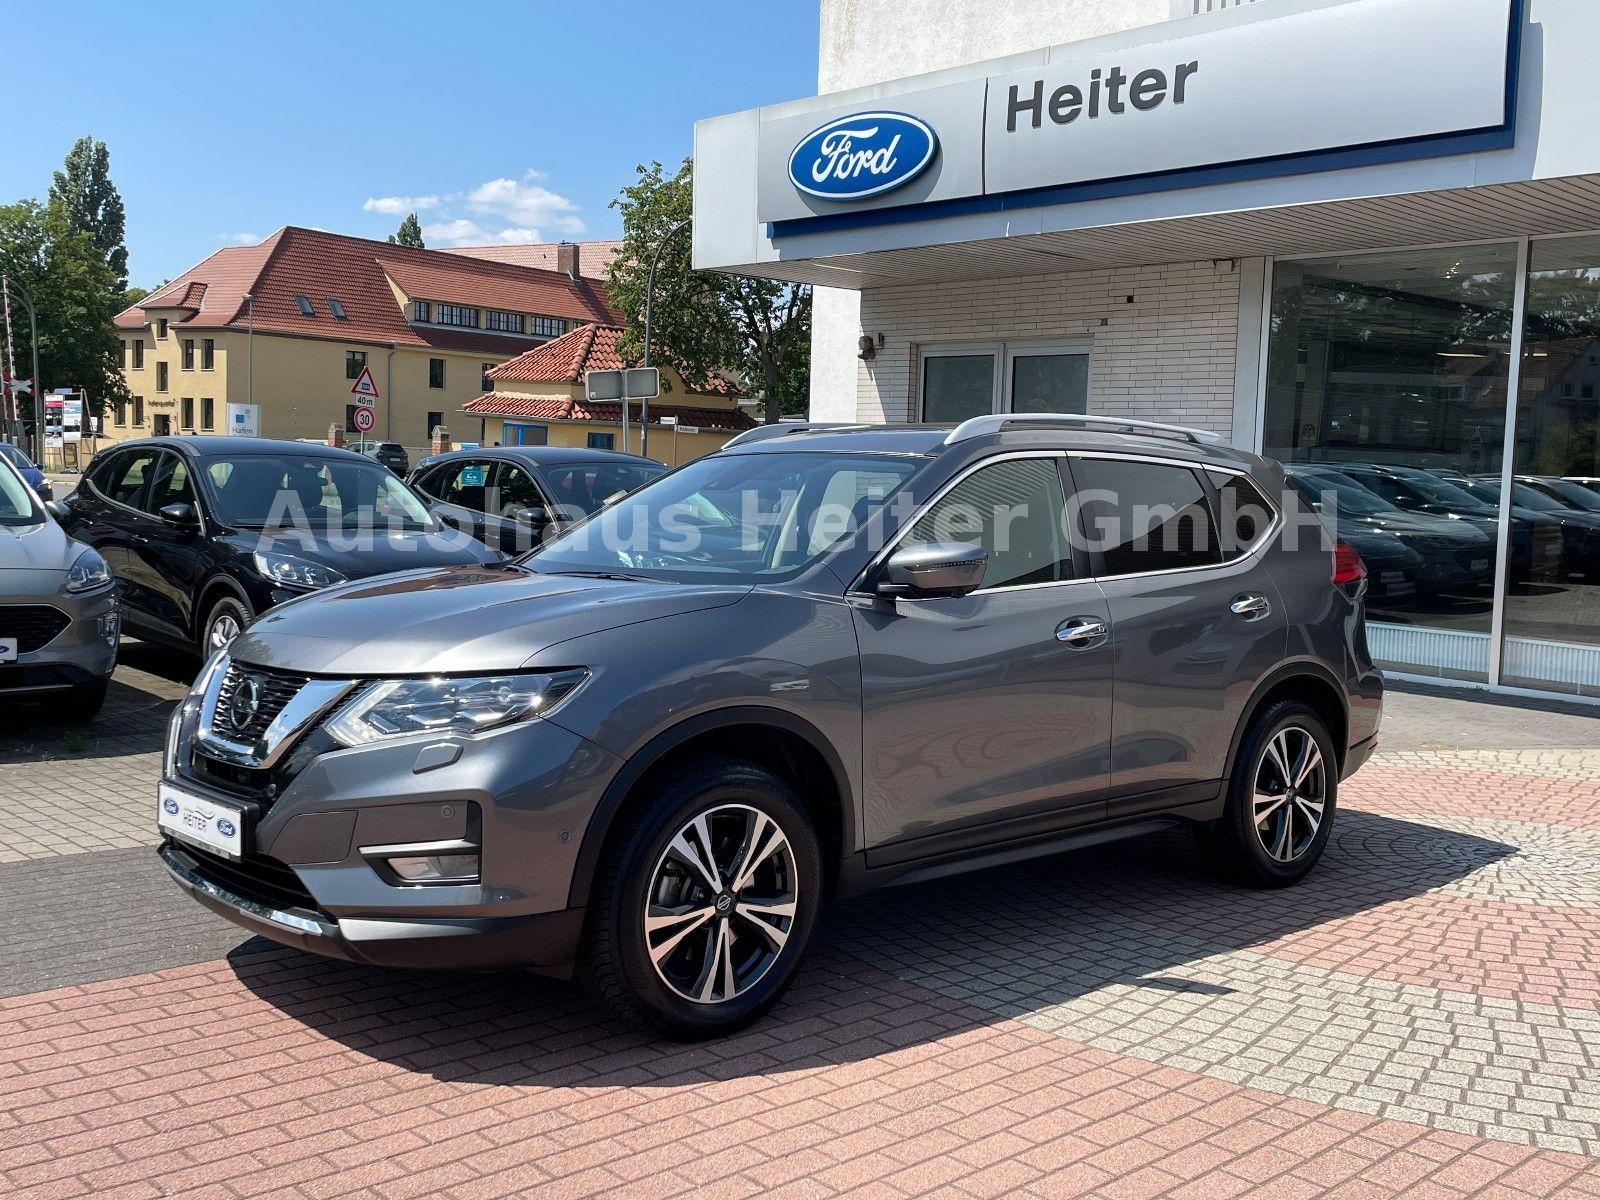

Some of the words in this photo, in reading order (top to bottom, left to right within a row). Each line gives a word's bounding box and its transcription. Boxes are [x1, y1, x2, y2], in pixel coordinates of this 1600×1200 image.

[1006, 60, 1198, 132] Heiter
[812, 126, 901, 183] Ford
[357, 396, 366, 405] 40
[359, 413, 370, 426] 30
[232, 426, 254, 435] Hafen
